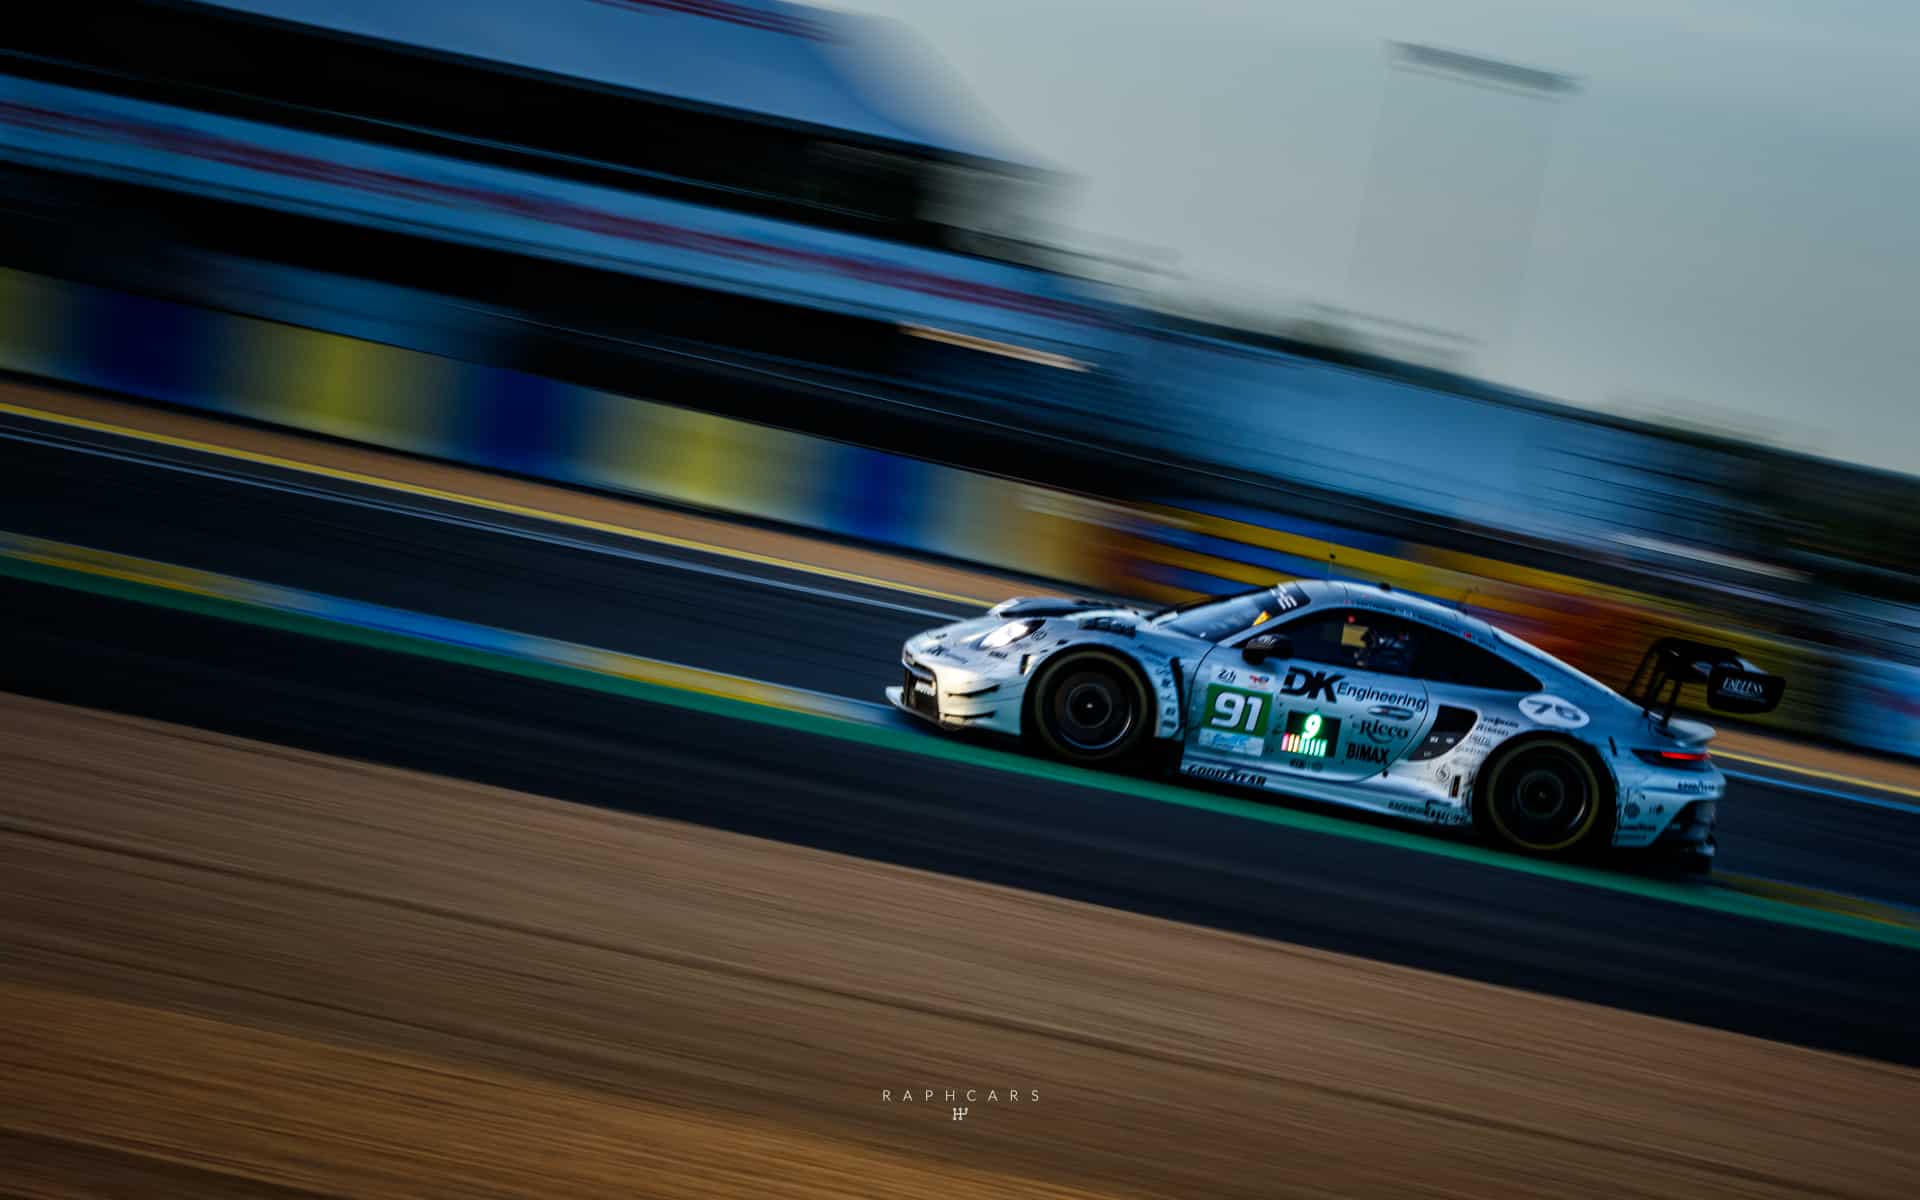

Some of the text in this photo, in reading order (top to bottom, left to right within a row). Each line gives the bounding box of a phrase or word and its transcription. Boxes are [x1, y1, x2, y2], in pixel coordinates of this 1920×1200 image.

[1280, 666, 1427, 712] DK Engineering
[1211, 691, 1264, 732] 91
[1302, 714, 1322, 739] 9
[1346, 743, 1391, 764] BIMAX
